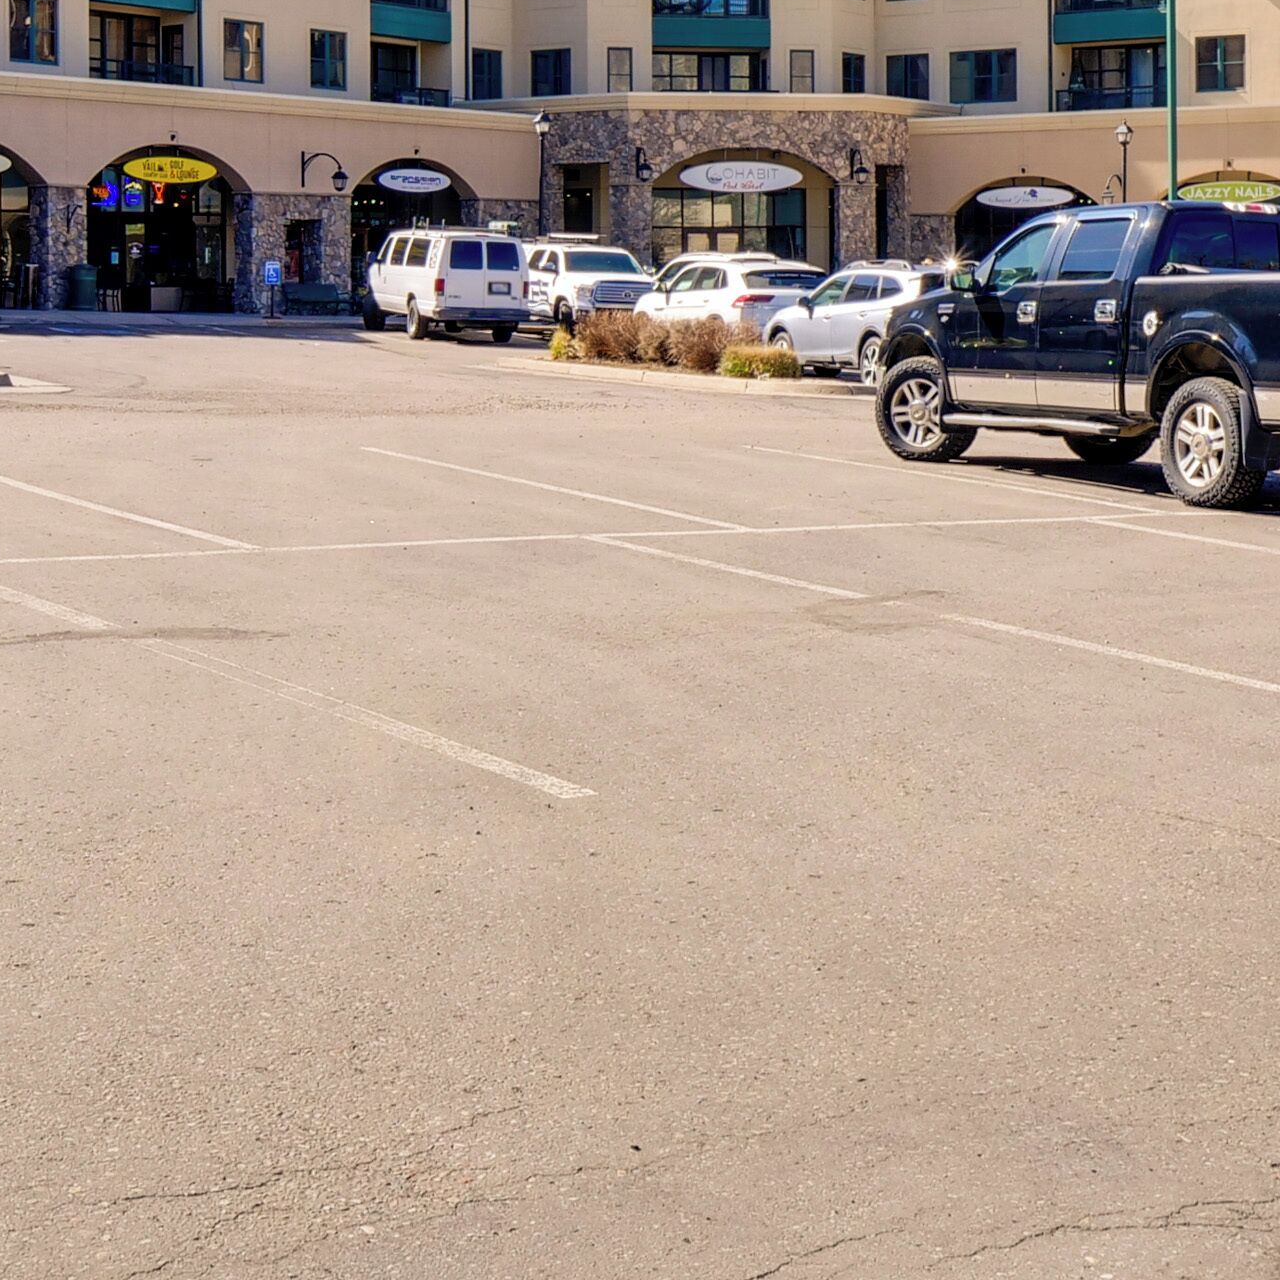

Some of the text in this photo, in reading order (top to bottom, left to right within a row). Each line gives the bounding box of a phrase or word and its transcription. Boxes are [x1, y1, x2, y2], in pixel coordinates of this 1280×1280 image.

[142, 160, 156, 171] VAIL
[170, 160, 184, 170] GOLF
[176, 167, 200, 181] LOUNGE
[1186, 185, 1275, 199] JAZZY NAILS
